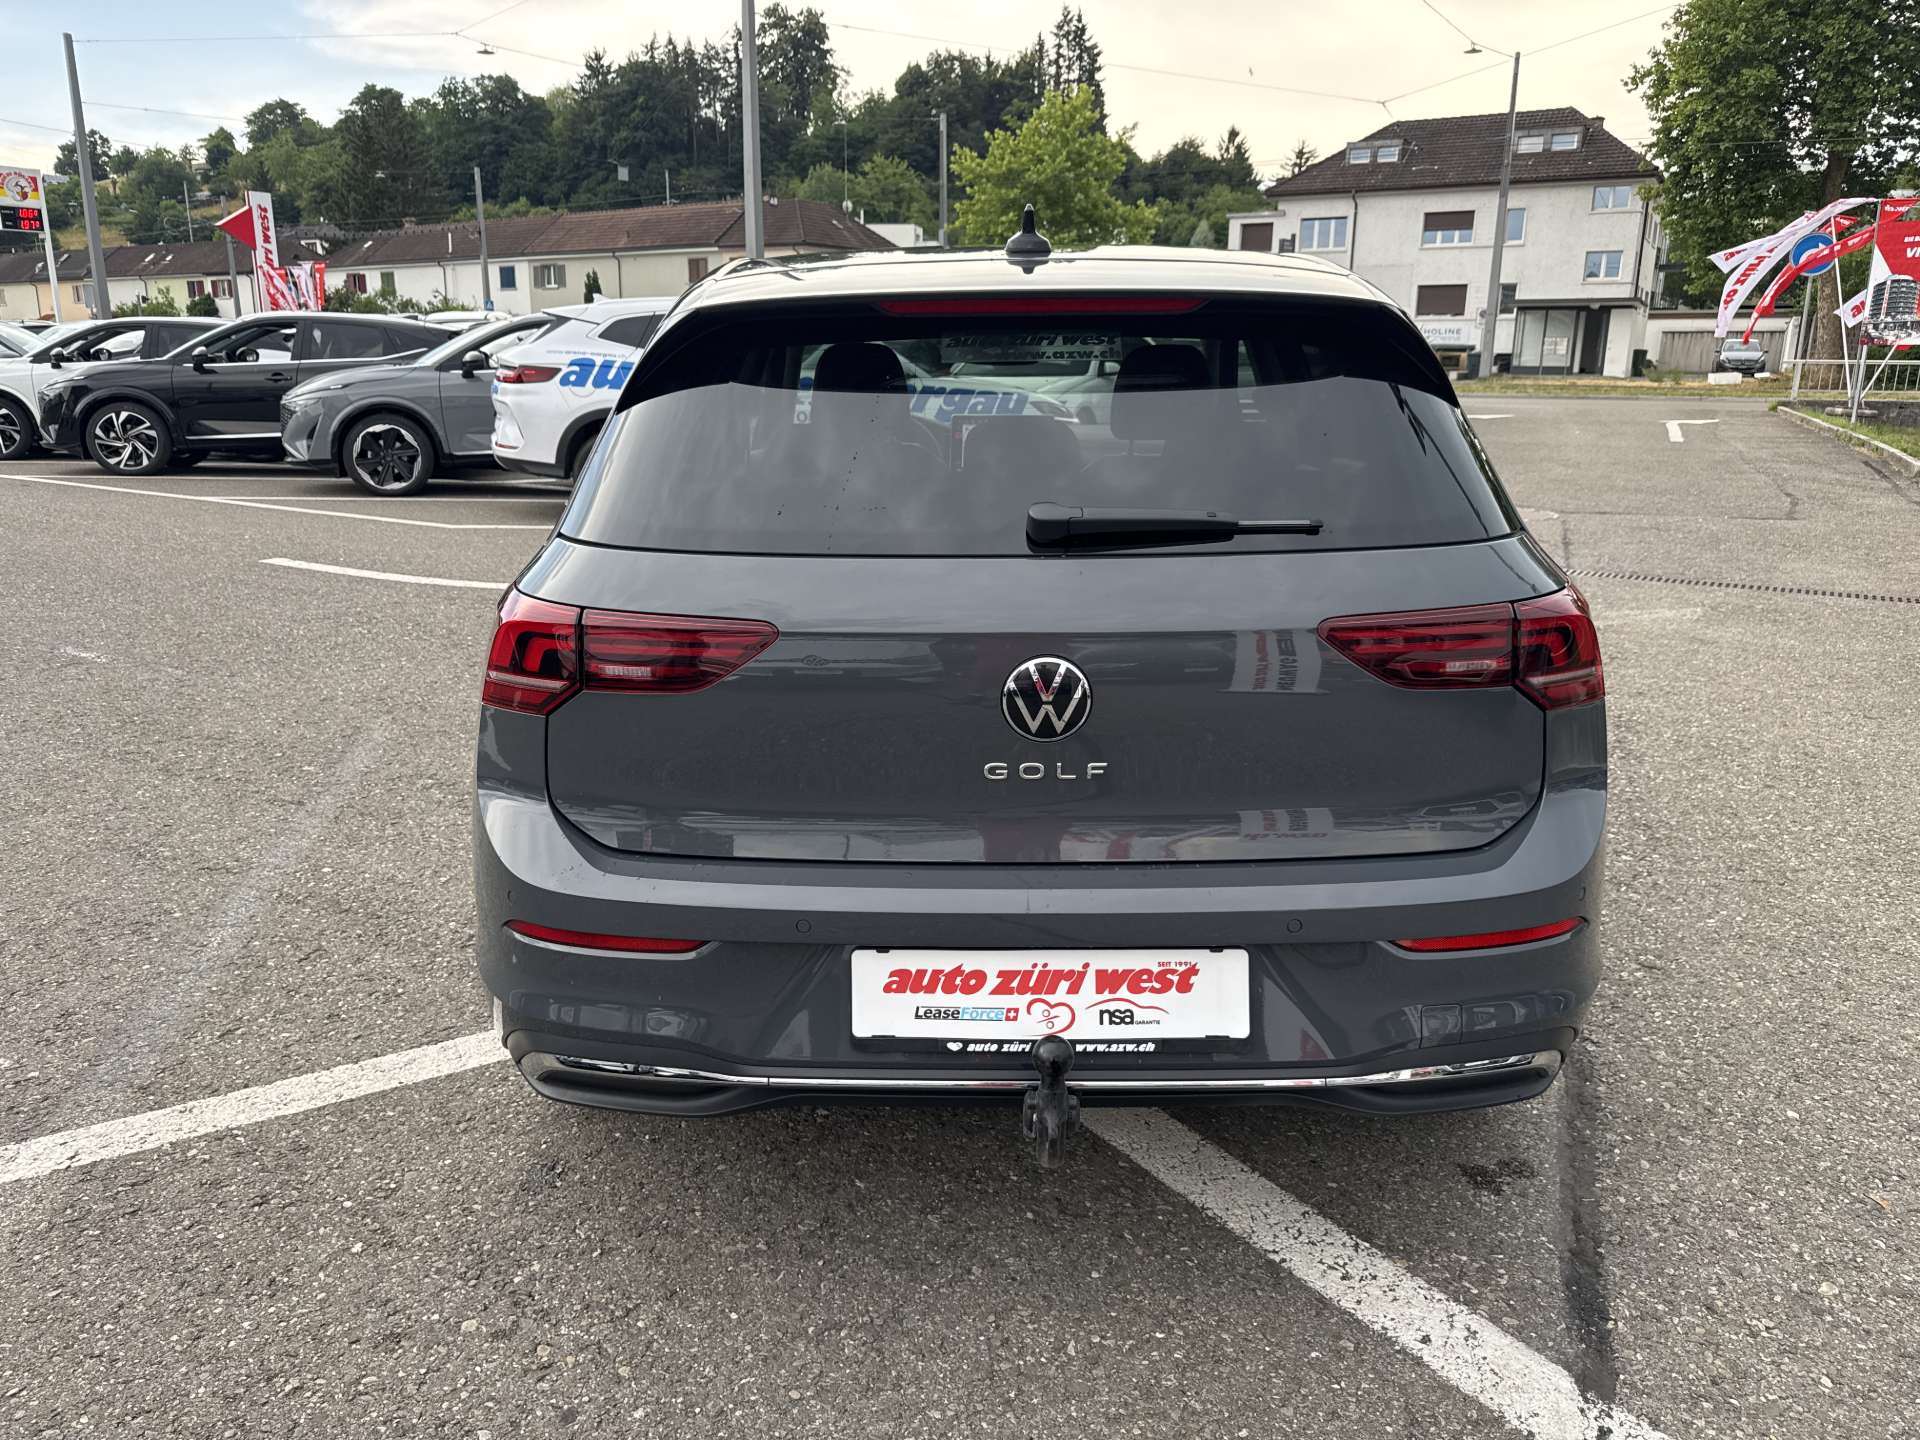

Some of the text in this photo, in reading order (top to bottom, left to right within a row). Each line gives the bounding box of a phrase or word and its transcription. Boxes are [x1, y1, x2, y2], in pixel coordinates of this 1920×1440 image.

[257, 203, 271, 245] west
[559, 357, 636, 390] au
[906, 383, 1030, 424] rgau
[983, 762, 1109, 780] GOLF
[882, 962, 1201, 996] auto züri west
[914, 1005, 1005, 1021] LeaseForce
[1099, 1008, 1135, 1026] nsa
[966, 1041, 1156, 1053] auto züri www.azw.ch
